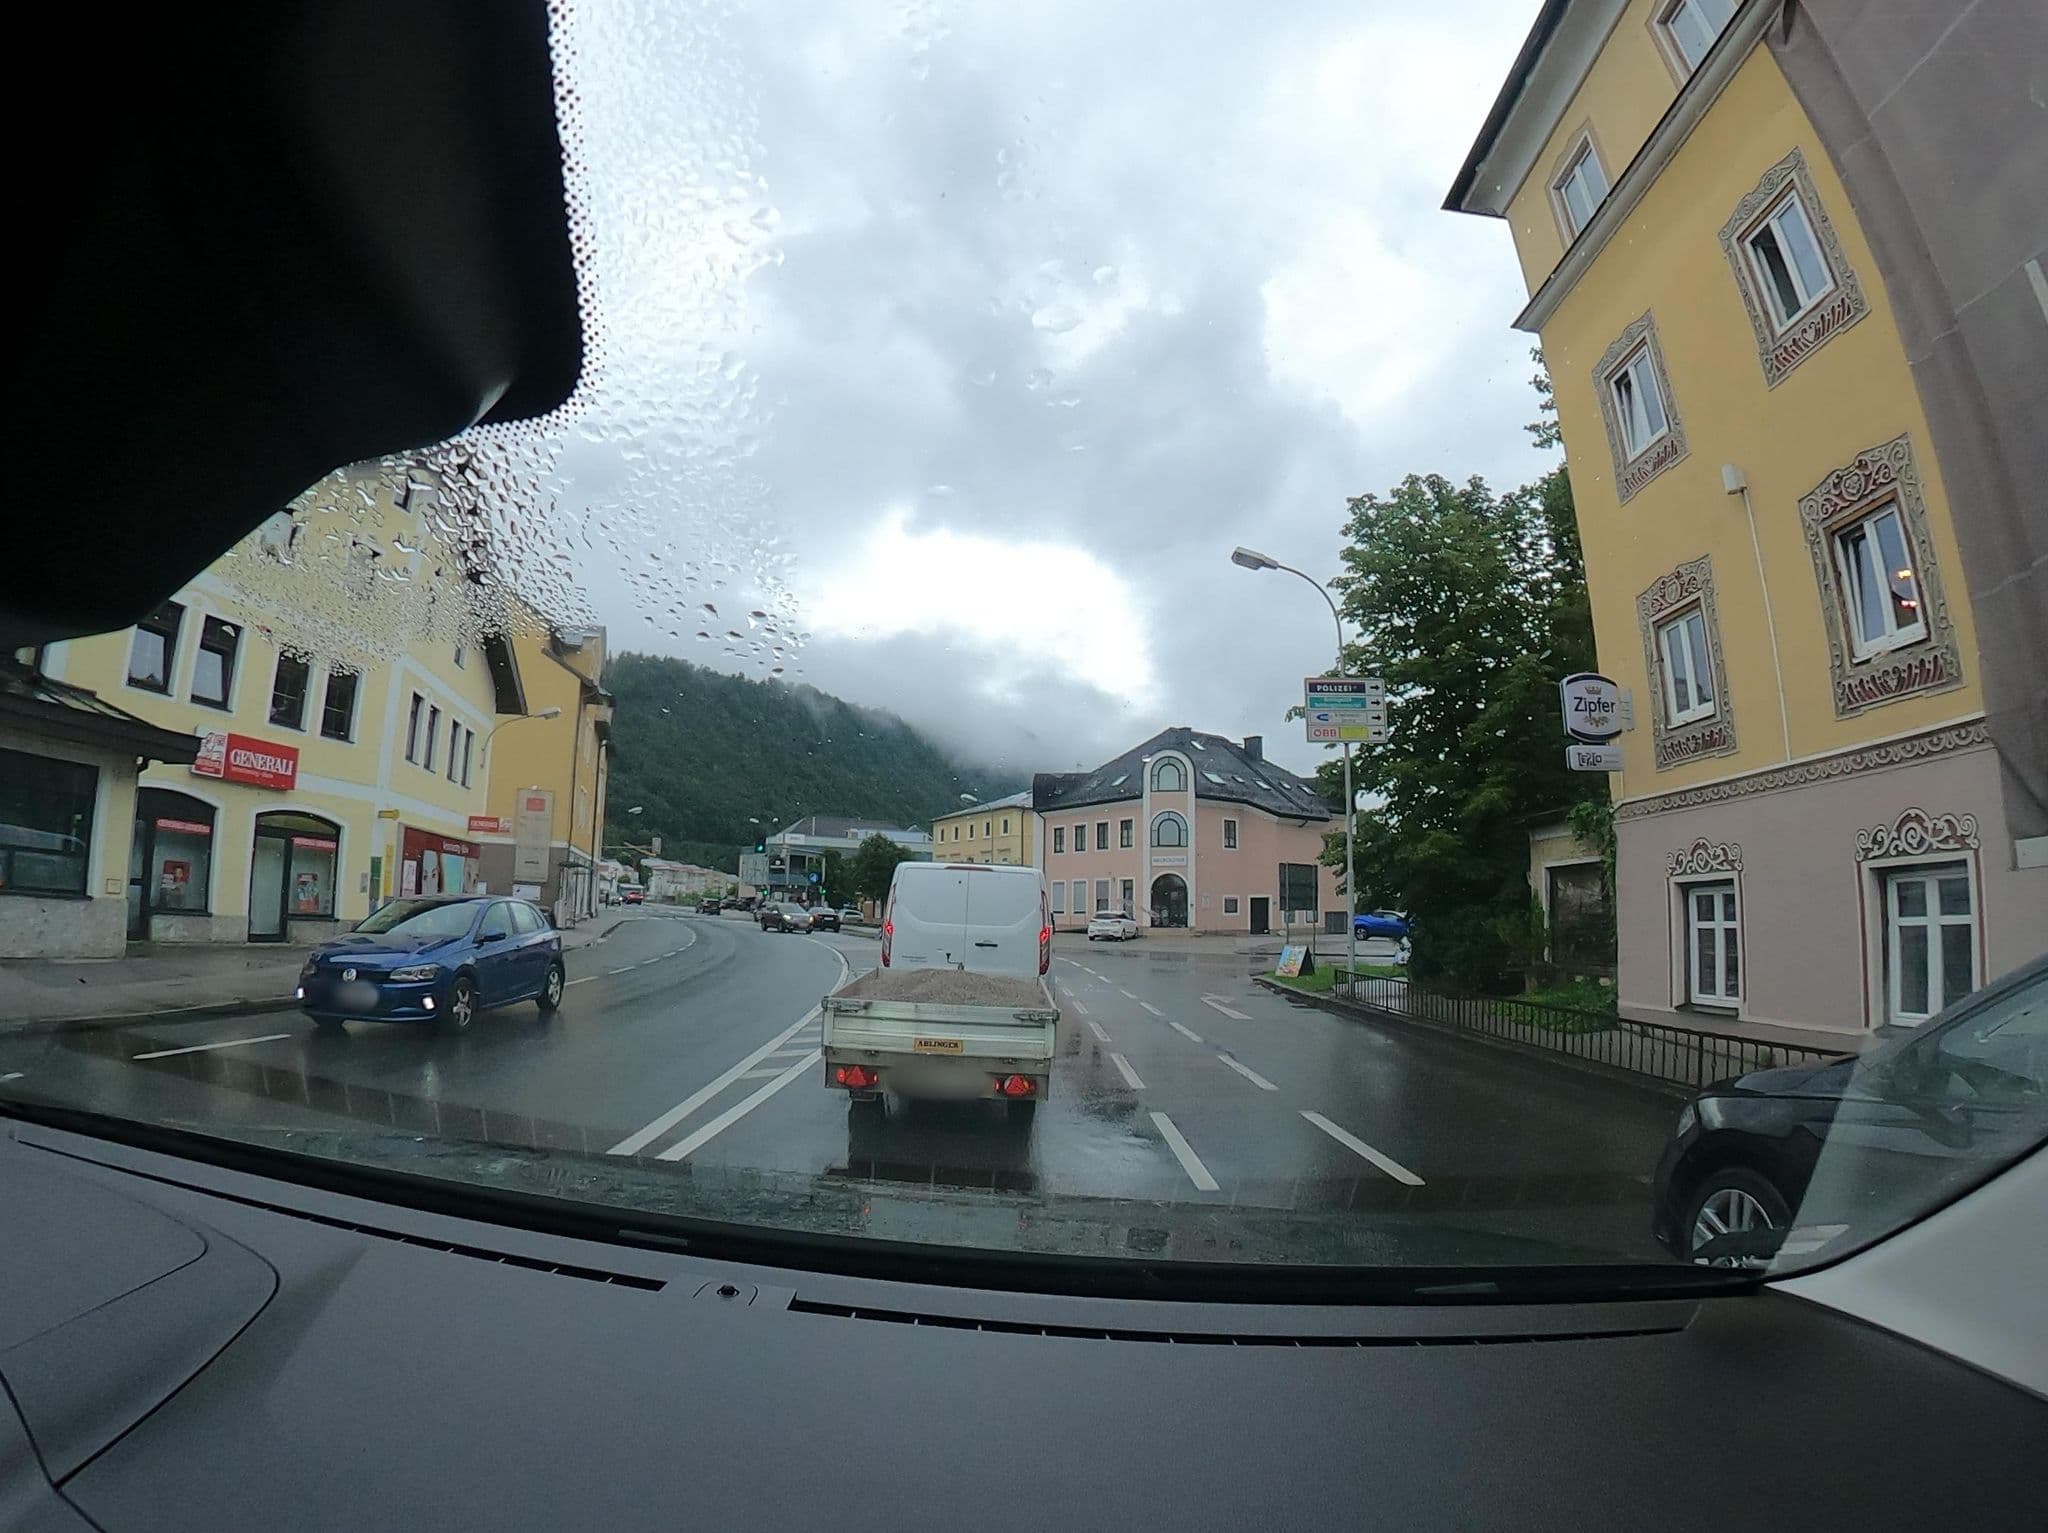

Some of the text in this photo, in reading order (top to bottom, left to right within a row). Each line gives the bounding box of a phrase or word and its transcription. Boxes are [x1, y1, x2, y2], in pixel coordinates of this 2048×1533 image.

[1316, 684, 1352, 692] POLIZEI
[1573, 696, 1617, 718] Zipfer
[230, 748, 294, 776] GENERALI
[917, 1039, 959, 1050] ABLINGER
